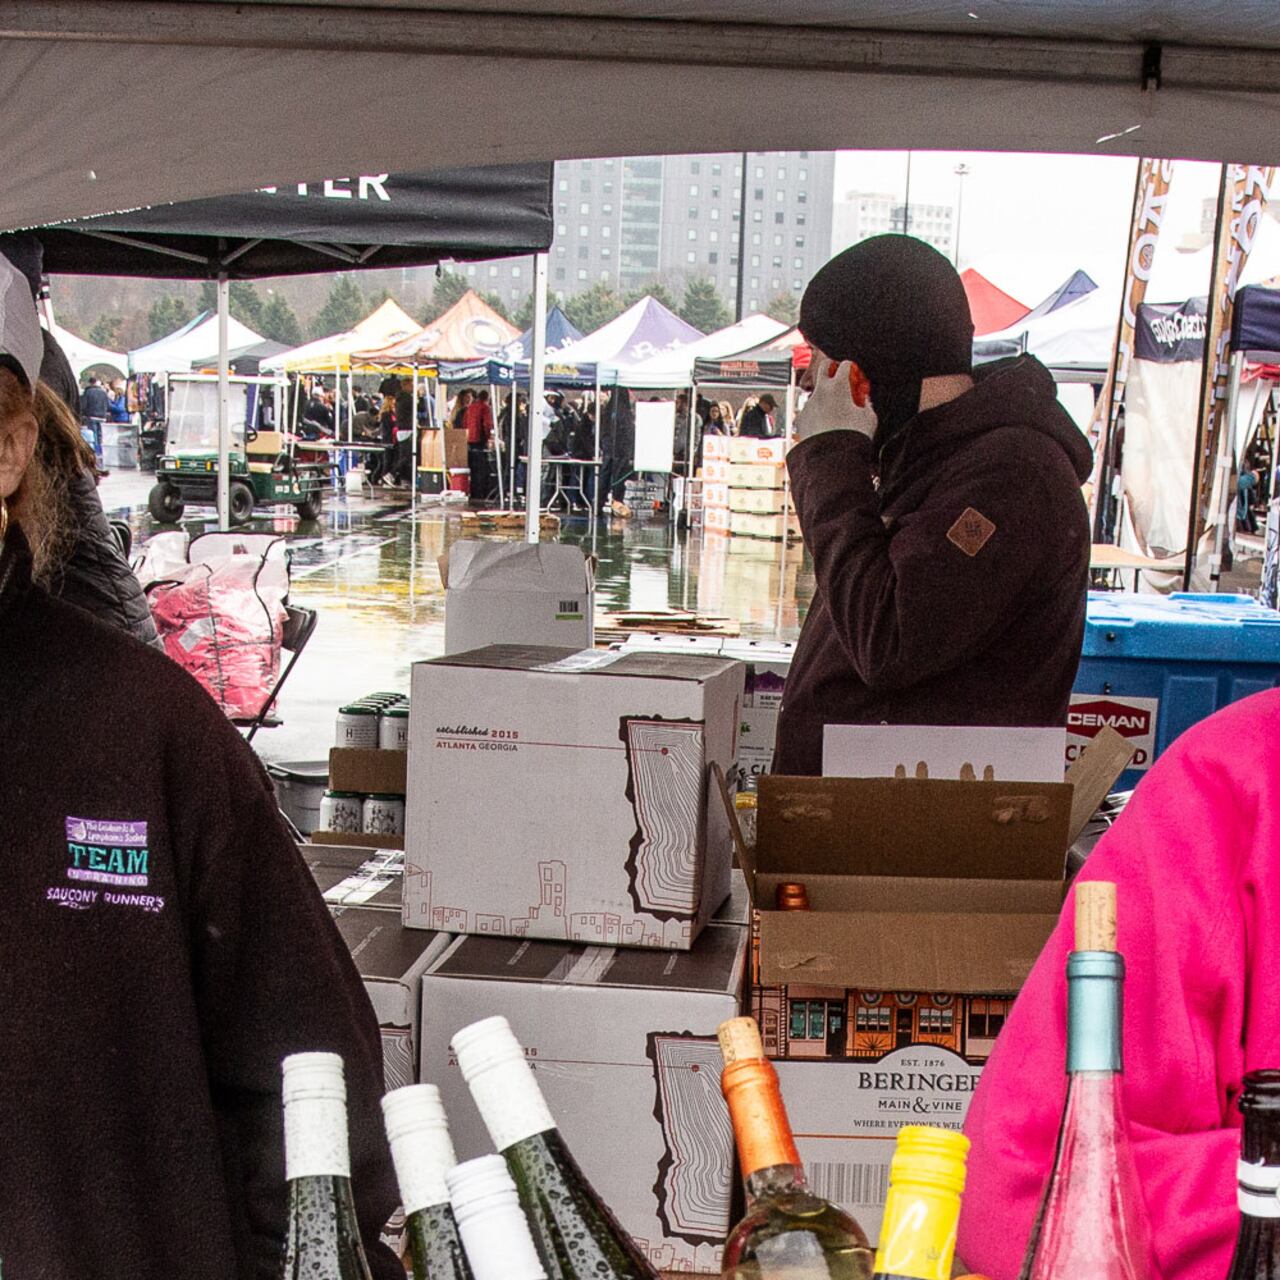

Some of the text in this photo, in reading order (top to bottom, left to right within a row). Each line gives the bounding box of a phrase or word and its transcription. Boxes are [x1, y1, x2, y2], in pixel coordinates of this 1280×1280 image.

[1067, 712, 1146, 729] CEMAN
[436, 725, 519, 739] established 2015
[436, 741, 519, 752] ATLANTA GEORGIA
[68, 843, 149, 874] TEAM
[47, 887, 98, 904] SAUCONY
[901, 1059, 946, 1067] EST. 1876
[878, 1096, 962, 1113] MAIN & VINE
[854, 1119, 885, 1128] WHERE
